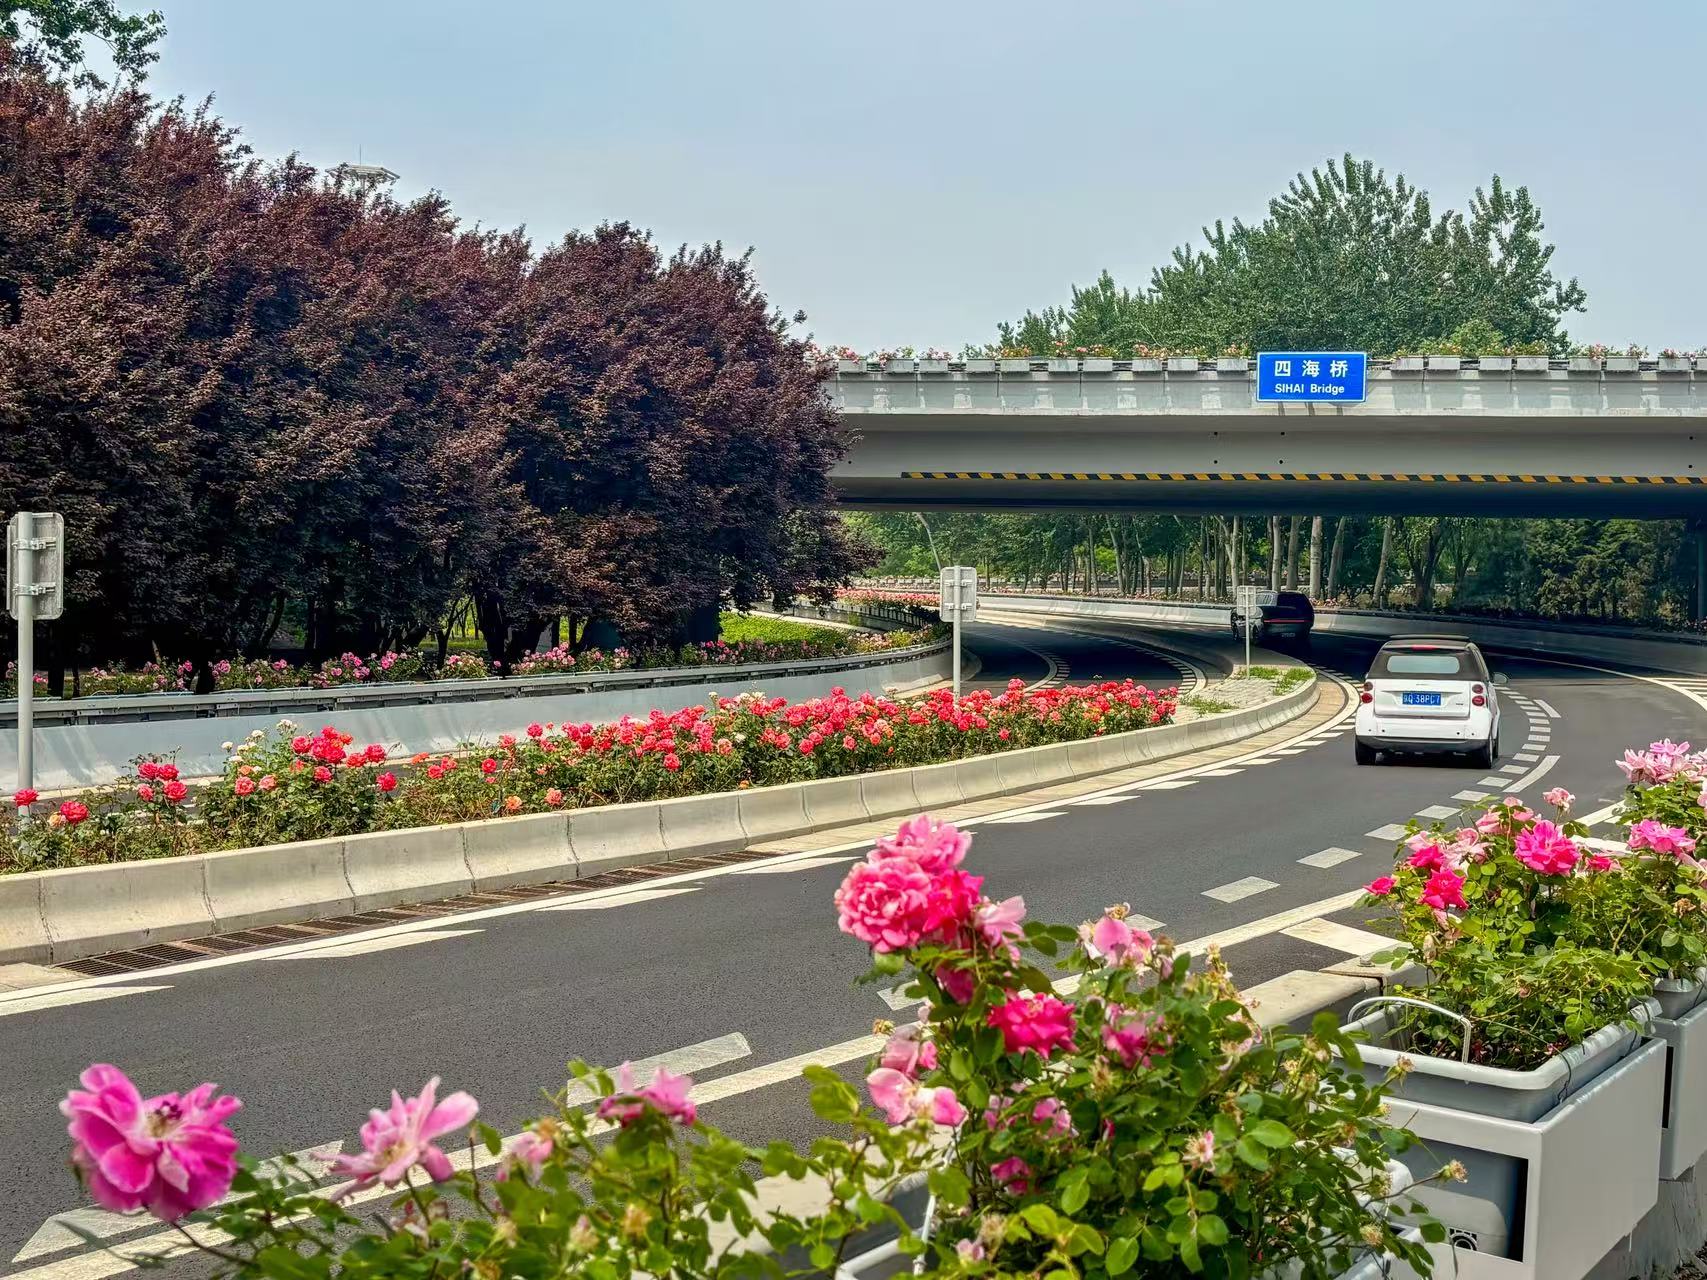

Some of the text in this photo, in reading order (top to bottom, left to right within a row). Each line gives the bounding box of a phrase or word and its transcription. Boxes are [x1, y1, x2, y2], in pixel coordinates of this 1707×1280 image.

[1274, 359, 1348, 377] 四海桥
[1275, 383, 1345, 395] SIHAI Bridge
